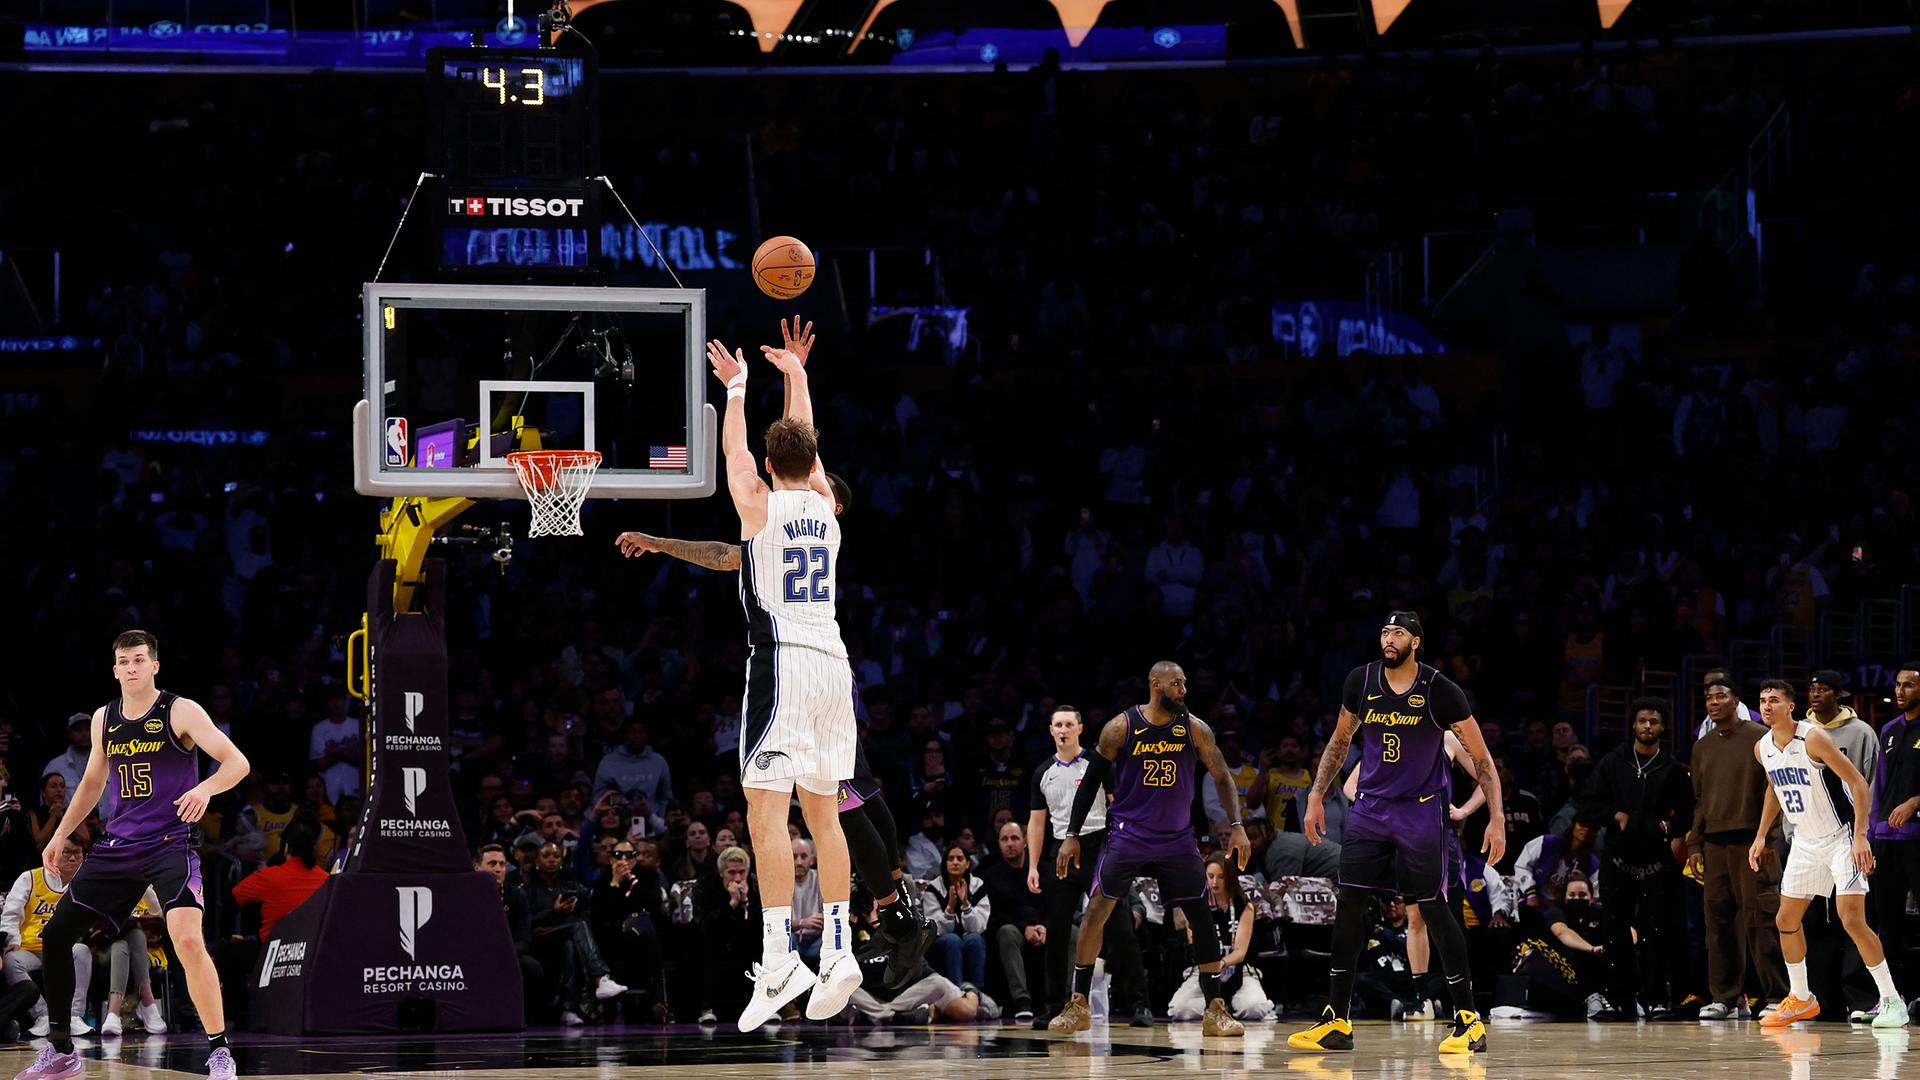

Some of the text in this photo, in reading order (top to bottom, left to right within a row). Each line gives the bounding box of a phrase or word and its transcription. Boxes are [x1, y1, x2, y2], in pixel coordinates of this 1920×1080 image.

[483, 67, 545, 105] 4.3
[486, 198, 584, 217] TISSOT
[783, 518, 827, 541] WAGNER
[783, 547, 830, 603] 22
[386, 735, 441, 745] PECHANGA
[1383, 733, 1400, 763] 3
[118, 762, 153, 798] 15
[1143, 759, 1177, 787] 23
[1768, 766, 1812, 786] MAGIC
[1782, 789, 1805, 813] 23
[380, 819, 450, 829] PECHANGA
[380, 830, 414, 838] RESORT
[1295, 892, 1338, 903] DELTA
[275, 941, 307, 963] PECHANGA
[286, 964, 302, 977] CASINO
[363, 965, 464, 982] PECHANGA
[364, 981, 465, 994] RESORT CASINO
